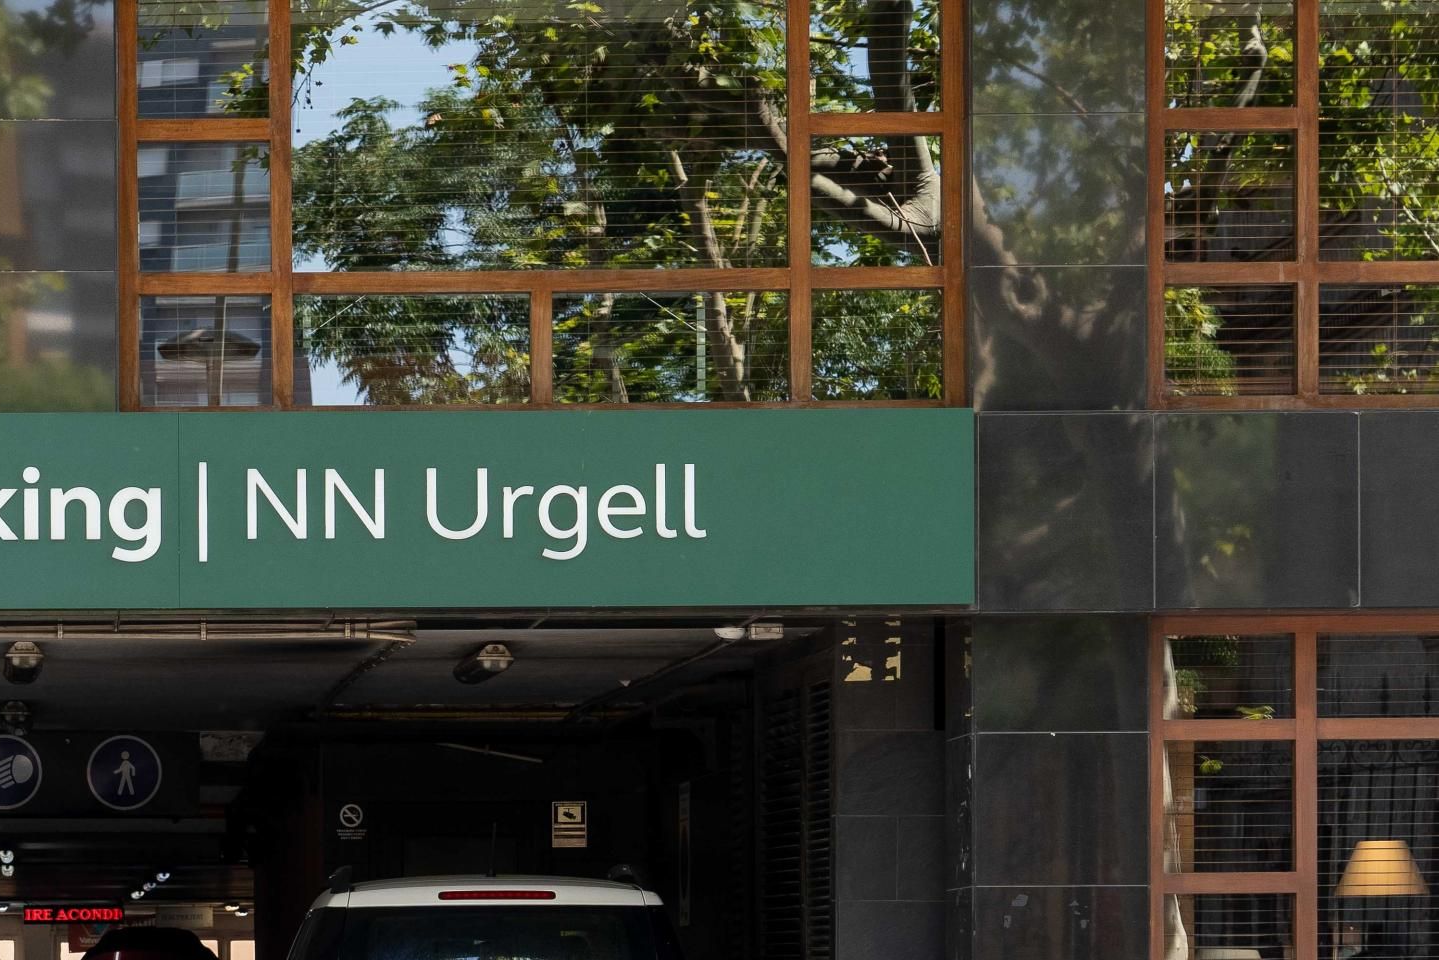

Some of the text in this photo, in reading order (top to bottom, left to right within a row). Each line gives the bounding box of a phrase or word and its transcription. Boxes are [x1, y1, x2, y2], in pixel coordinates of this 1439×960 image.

[246, 468, 385, 540] NN
[426, 463, 707, 561] Urgell
[24, 908, 54, 921] IRE
